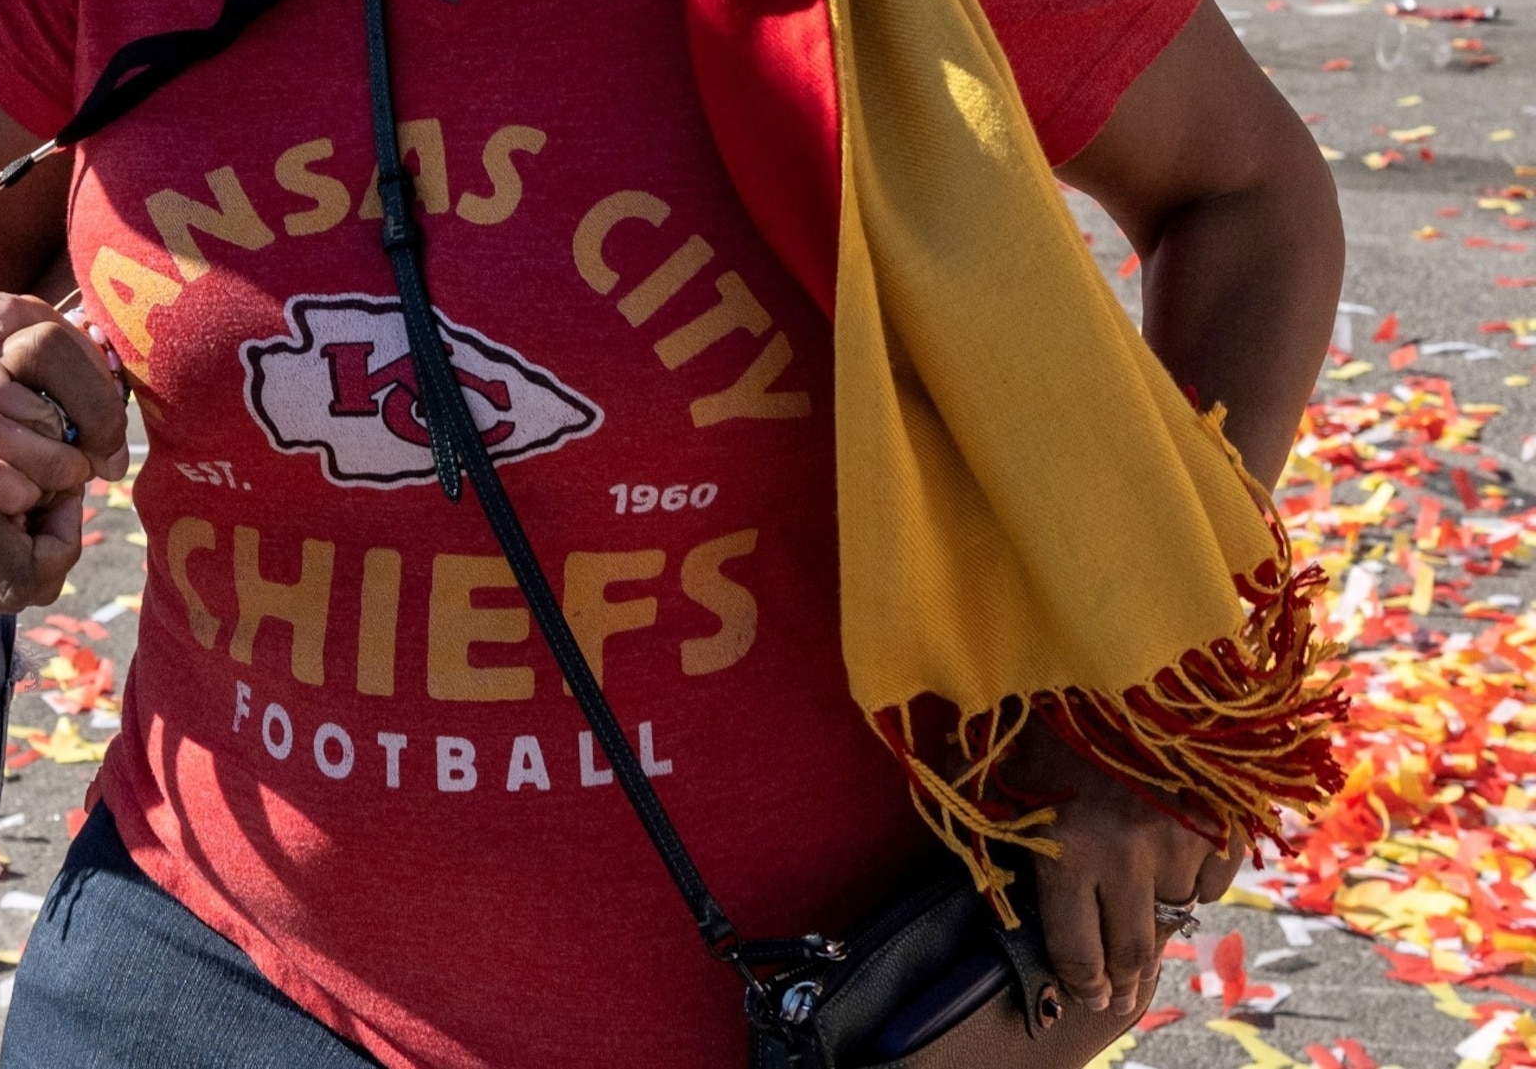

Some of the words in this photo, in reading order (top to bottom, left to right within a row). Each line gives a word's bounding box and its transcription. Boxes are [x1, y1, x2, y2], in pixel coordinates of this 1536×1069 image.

[90, 118, 547, 384] ANSAS
[573, 190, 812, 428] CITY
[175, 460, 252, 492] EST.
[609, 483, 719, 515] 1960
[167, 515, 759, 703] CHIEFS
[231, 679, 673, 793] FOOTBALL
